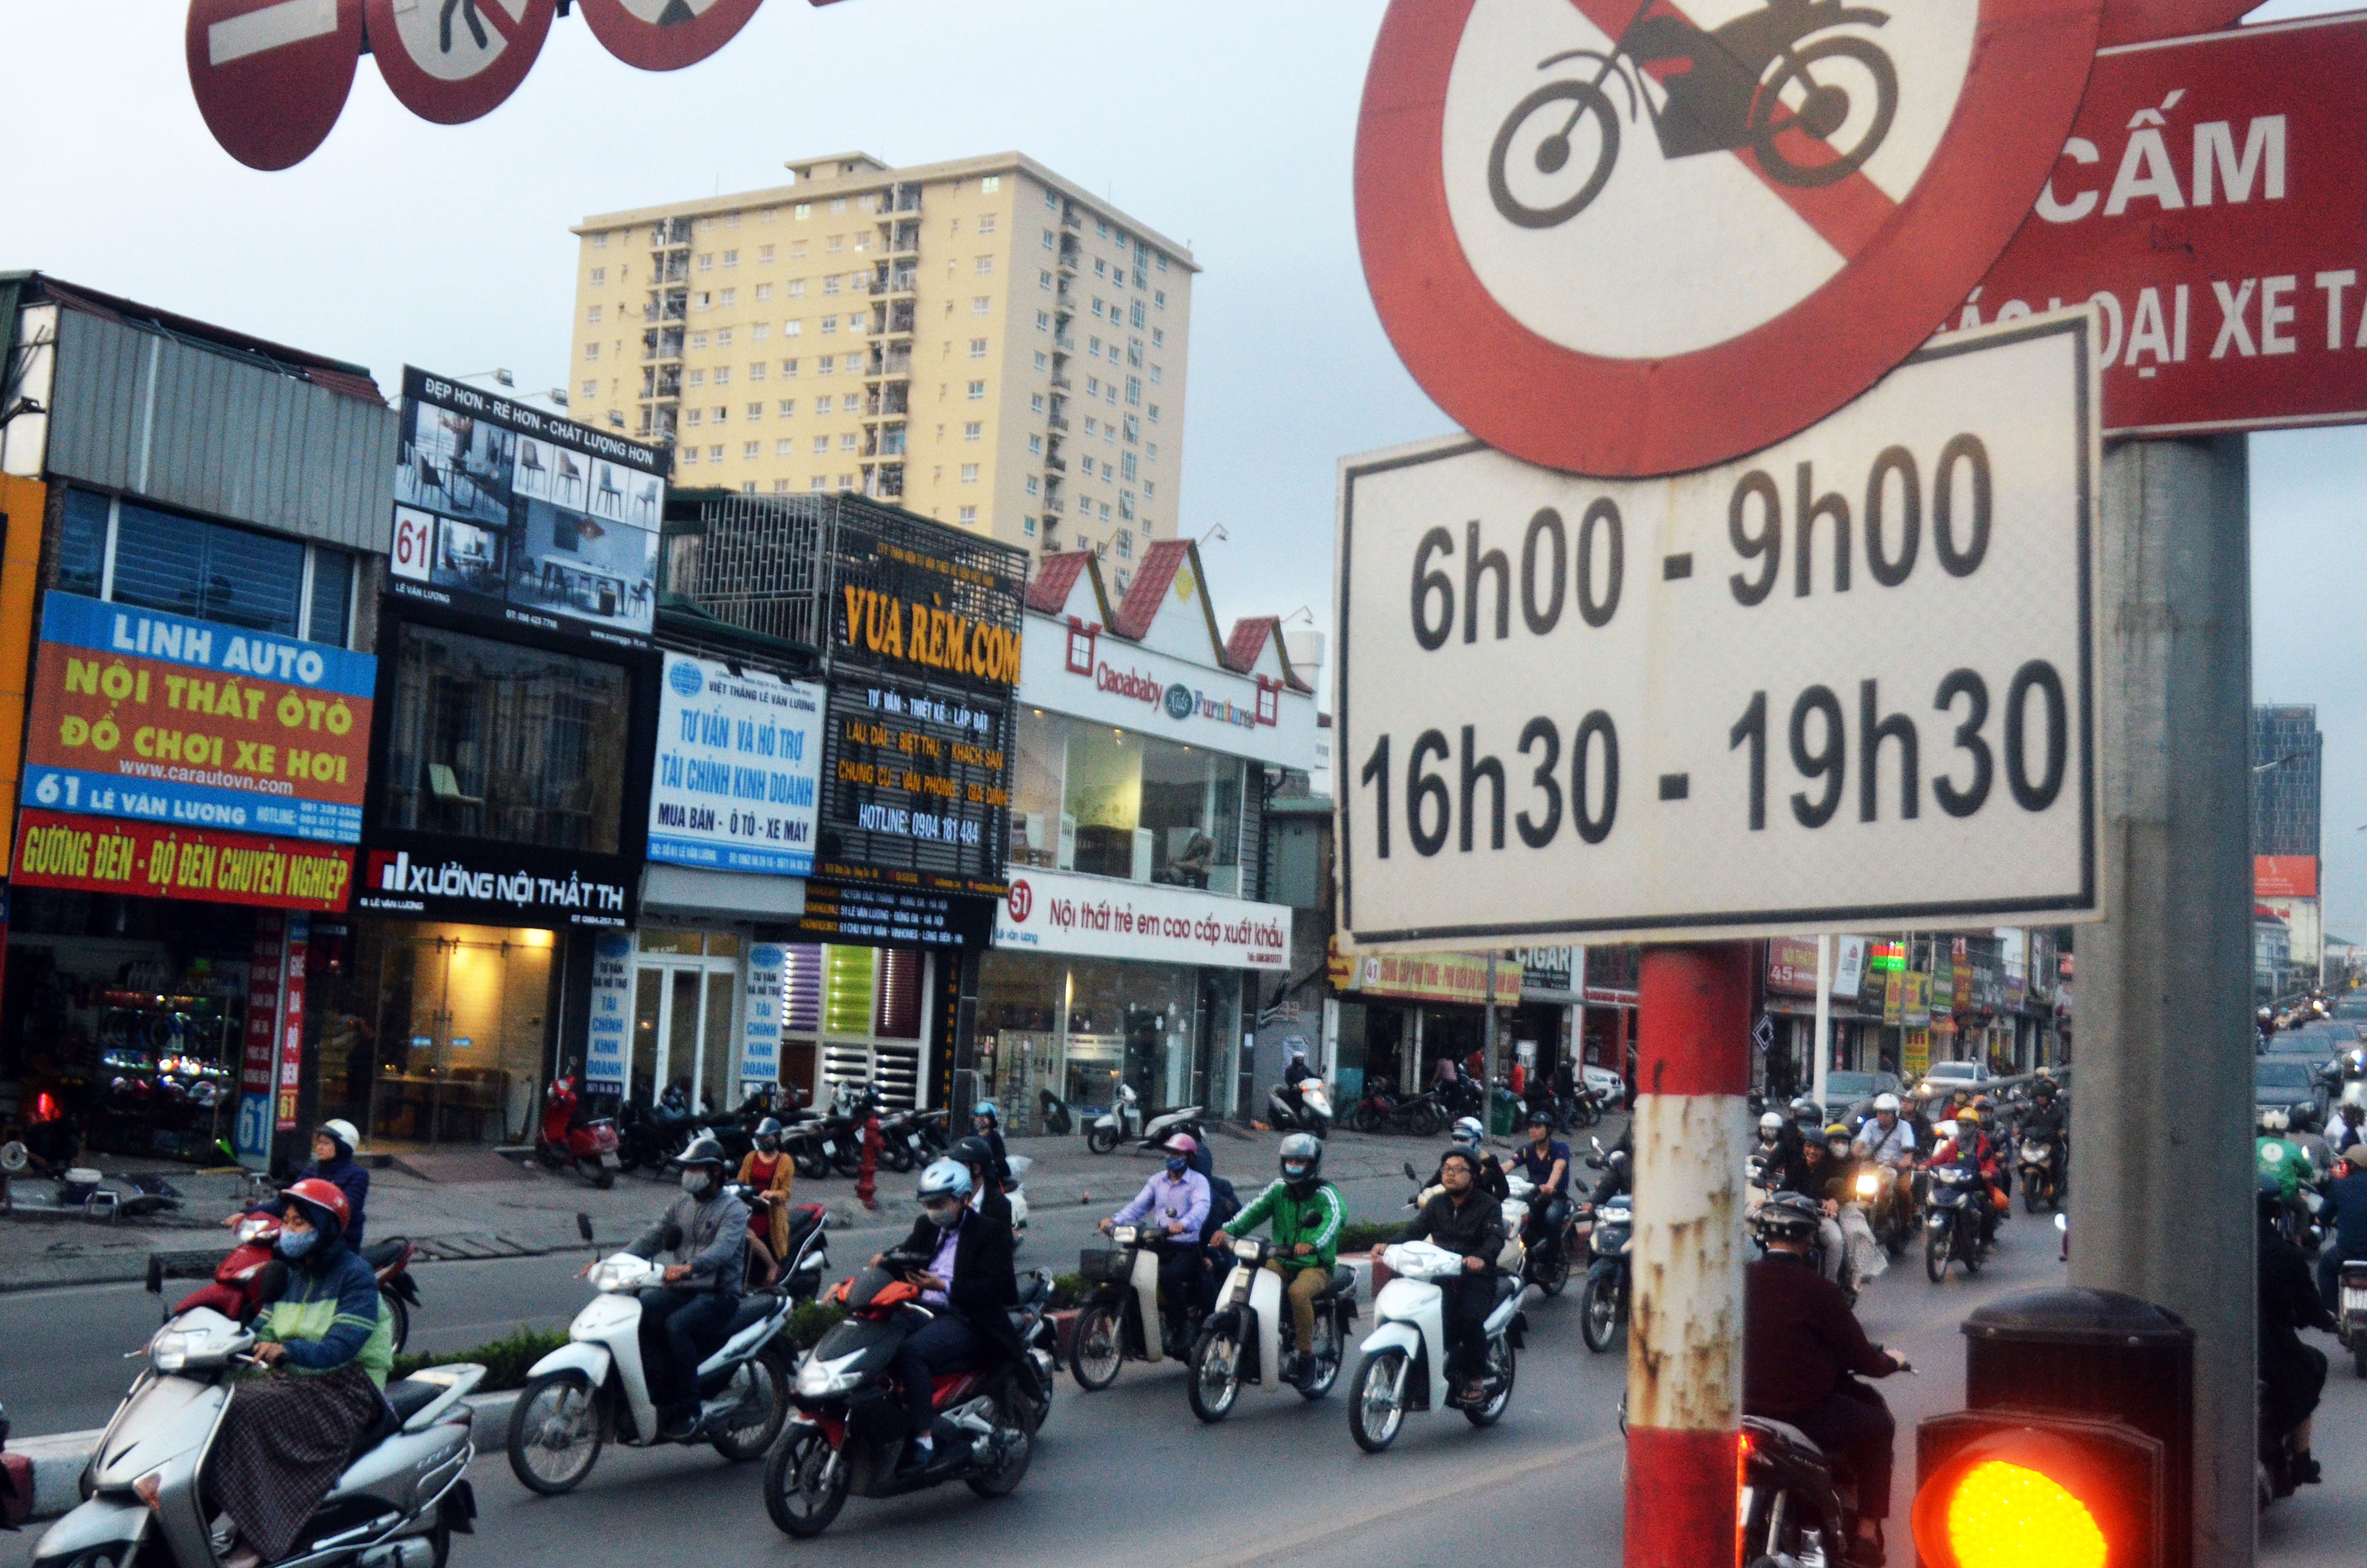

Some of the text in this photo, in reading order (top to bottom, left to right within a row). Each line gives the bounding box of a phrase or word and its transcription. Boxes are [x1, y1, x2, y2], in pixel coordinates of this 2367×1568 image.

[2034, 88, 2286, 223] CẤM
[2048, 284, 2188, 378] OẠI
[2209, 275, 2295, 359] XE
[2315, 269, 2367, 351] T
[425, 377, 451, 401] ĐẸP
[454, 389, 483, 410] HƠN
[493, 398, 510, 419] RẺ
[513, 410, 541, 429] HƠN
[550, 417, 582, 442] CHẤT
[584, 430, 626, 457] LƯỢNG
[628, 445, 654, 465] HƠN
[397, 520, 428, 568] 61
[1410, 433, 1992, 652] 6h00 - 9h00
[395, 582, 405, 593] LÊ
[113, 614, 324, 683] LINH AUTO
[844, 584, 1022, 685] VUA RÈM.COM
[65, 658, 353, 736] NỘI THẤT ÔTÔ
[709, 680, 727, 695] VIỆT
[759, 689, 768, 703] LÊ
[771, 692, 788, 706] VĂN
[790, 699, 815, 712] LƯƠNG
[60, 709, 347, 783] ĐỒ CHƠI XE HƠI
[681, 704, 804, 768] TƯ VẤN VÀ HỖ TRỢ
[1361, 658, 2068, 860] 16h30 - 19h30
[36, 773, 80, 806] 61
[90, 788, 115, 810] LÊ
[119, 759, 293, 795] www.carautovn.com
[661, 749, 813, 808] TÀI CHÍNH KINH DOANH
[838, 760, 874, 784] CHUNG
[967, 782, 983, 802] GIA
[658, 802, 808, 843] MUA BÁN Ô TÔ XE MÁY
[859, 802, 979, 843] HOTLINE: 0904 181 484
[22, 824, 92, 877] GƯƠNG
[93, 826, 135, 881] ĐÈN
[177, 835, 217, 888] ĐÈN
[217, 843, 287, 895] CHUYÊN
[286, 850, 348, 908] NGHIỆP
[409, 861, 623, 910] XƯỞNG NỘI THẤT TH
[1012, 887, 1029, 914] 51
[1050, 898, 1283, 947] Nội thất trẻ em cao cấp xuất khẩu
[1514, 945, 1570, 971] CIGAR
[1951, 937, 1966, 954] 21
[1367, 963, 1377, 979] 41
[1770, 965, 1793, 981] 45
[747, 1019, 777, 1036] CHÍNH
[749, 1042, 772, 1056] KINH
[742, 1061, 776, 1076] DOANH
[238, 1097, 268, 1149] 61
